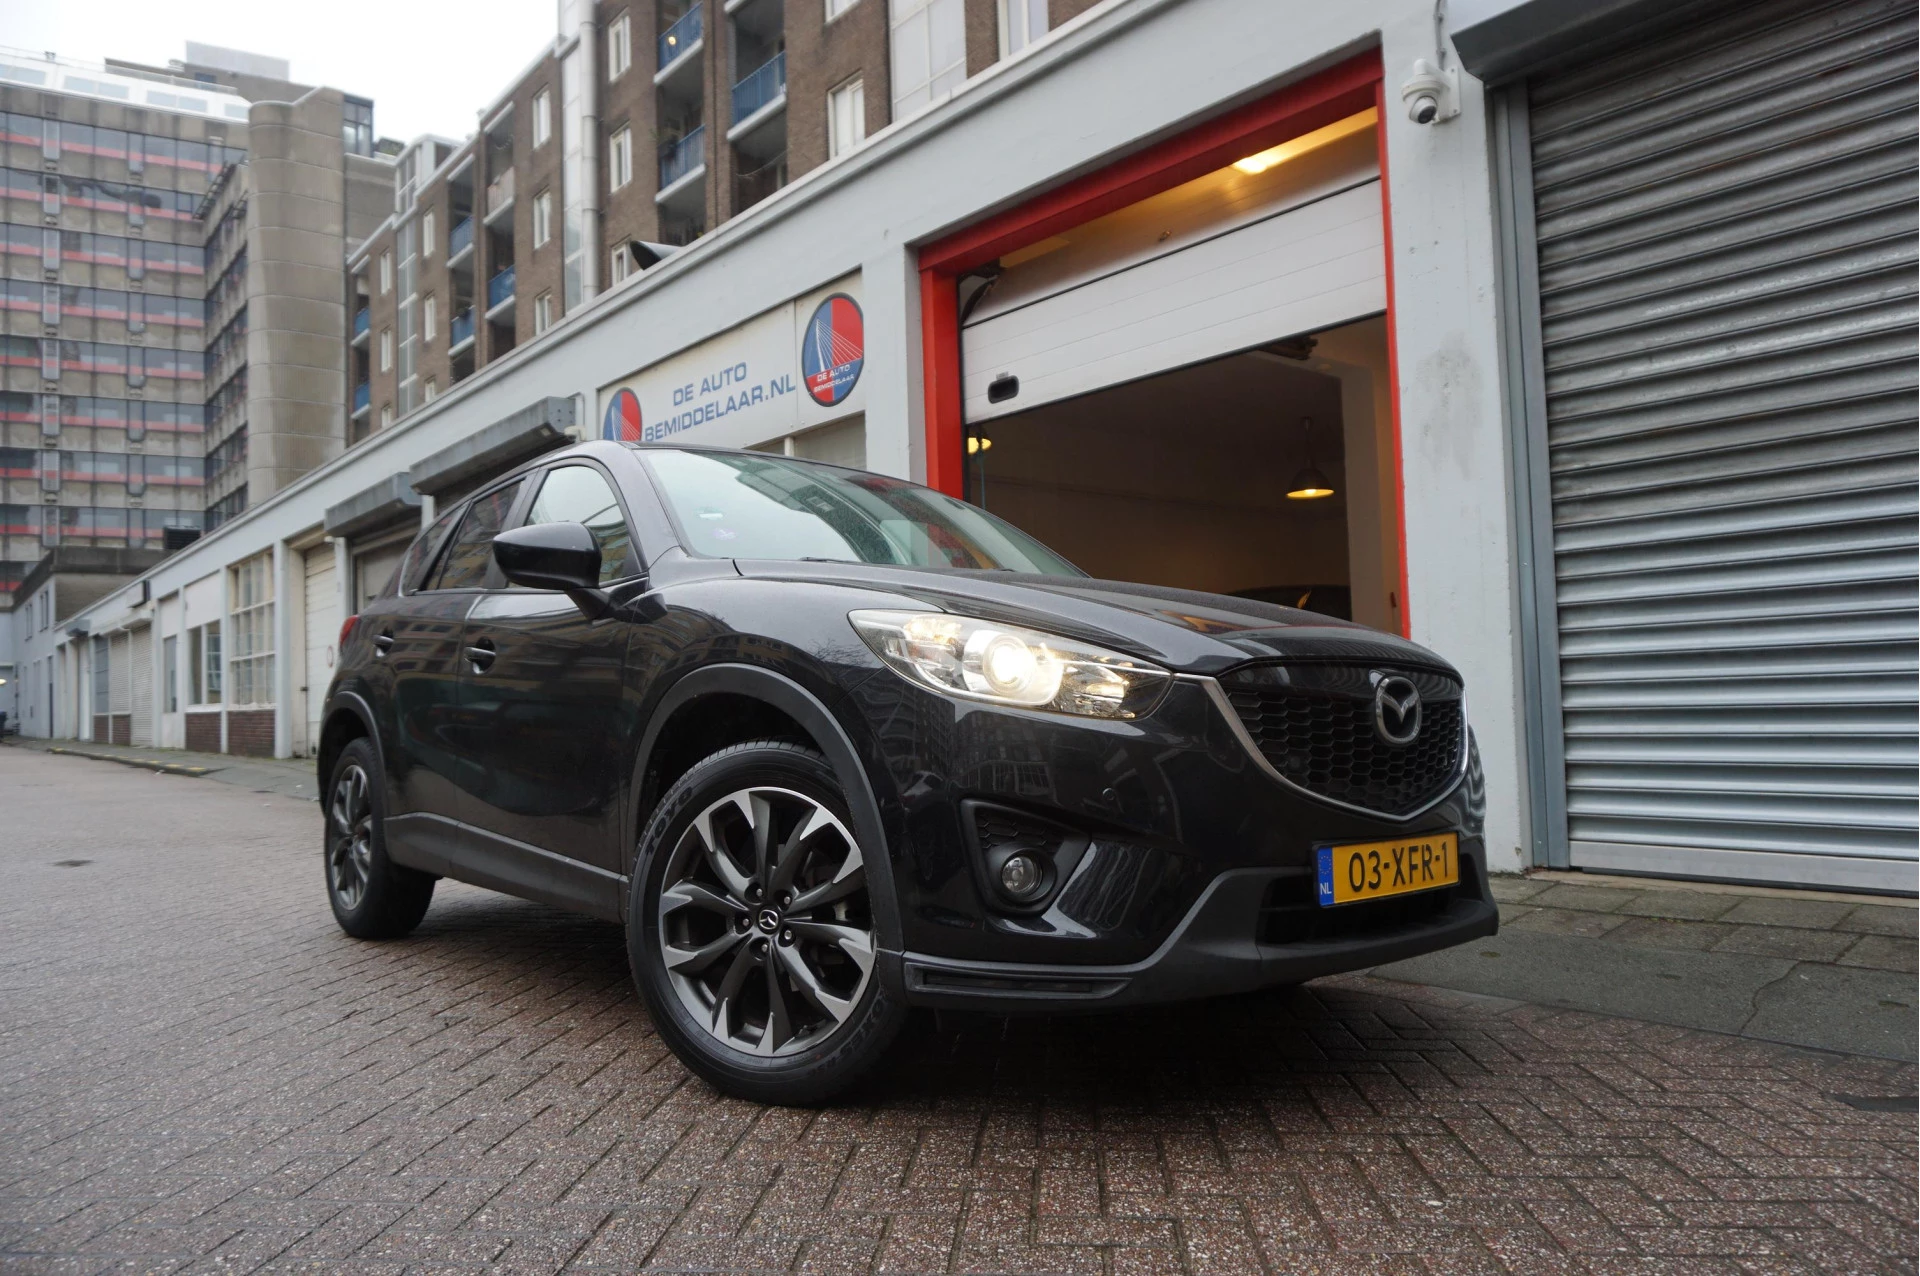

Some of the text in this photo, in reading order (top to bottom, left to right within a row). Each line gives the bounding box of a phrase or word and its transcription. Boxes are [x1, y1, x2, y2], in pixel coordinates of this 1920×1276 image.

[673, 361, 747, 406] DE AUTO
[816, 364, 851, 382] DE AUTO
[644, 374, 796, 441] BEMIDDELAAR.NL
[645, 786, 693, 855] TOYO
[1319, 883, 1333, 895] NL
[1348, 841, 1449, 892] 03-XFR-1
